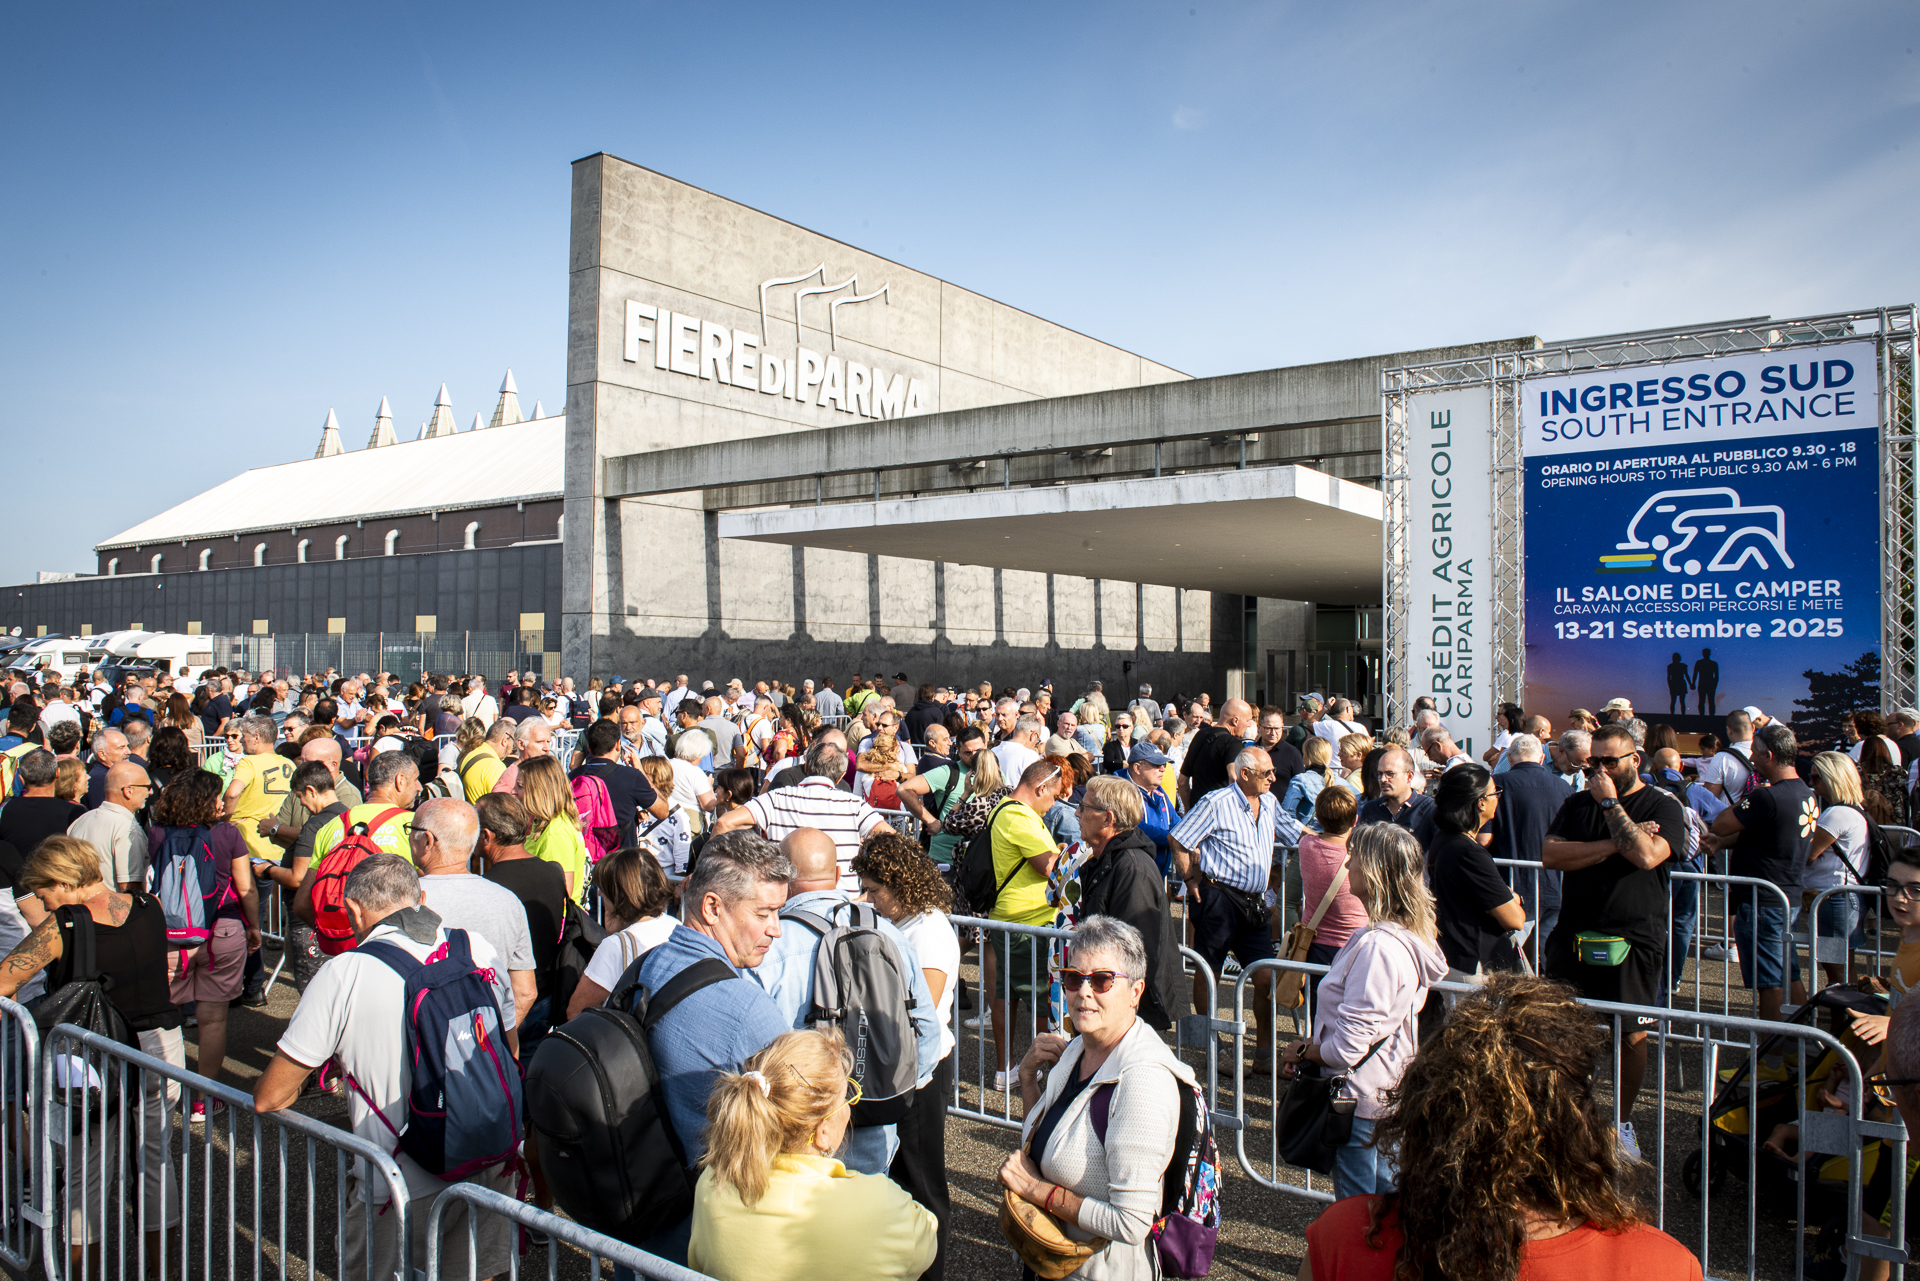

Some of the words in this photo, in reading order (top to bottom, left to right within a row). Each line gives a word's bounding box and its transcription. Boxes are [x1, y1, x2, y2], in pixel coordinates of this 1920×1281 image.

[623, 299, 759, 391] FIERE
[760, 352, 796, 400] DI
[796, 346, 926, 419] PARMA
[1540, 370, 1747, 417] INGRESSO
[1760, 359, 1855, 394] SUD
[1541, 411, 1650, 442] SOUTH
[1662, 391, 1856, 431] ENTRANCE
[1541, 462, 1592, 476] ORARIO
[1595, 461, 1610, 472] DI
[1612, 455, 1688, 470] APERTURA
[1691, 453, 1710, 464] AL
[1713, 447, 1789, 463] PUBBLICO
[1792, 444, 1826, 457] 9.30
[1839, 441, 1856, 453] 18
[1541, 475, 1597, 489] OPENING
[1600, 471, 1645, 484] HOURS
[1648, 469, 1667, 481] TO
[1670, 467, 1696, 479] THE
[1700, 464, 1748, 477] PUBLIC
[1751, 461, 1782, 474] 9.30
[1785, 460, 1809, 471] AM
[1822, 458, 1831, 469] 6
[1835, 456, 1857, 467] PM
[1431, 409, 1453, 583] AGRICOLE
[1553, 603, 1621, 615] CARAVAN
[1624, 601, 1705, 613] ACCESSORI
[1709, 600, 1783, 612] PERCORSI
[1788, 599, 1797, 610] E
[1802, 598, 1843, 610] METE
[1556, 587, 1575, 603] IL
[1581, 584, 1674, 602] SALONE
[1681, 582, 1728, 600] DEL
[1735, 579, 1841, 598] CAMPER
[1457, 558, 1473, 718] CARIPARMA
[1554, 620, 1615, 639] 13-21
[1622, 618, 1762, 639] Settembre
[1770, 617, 1844, 638] 2025
[1426, 594, 1453, 718] CRÉDIT
[855, 1025, 868, 1088] DESIGN
